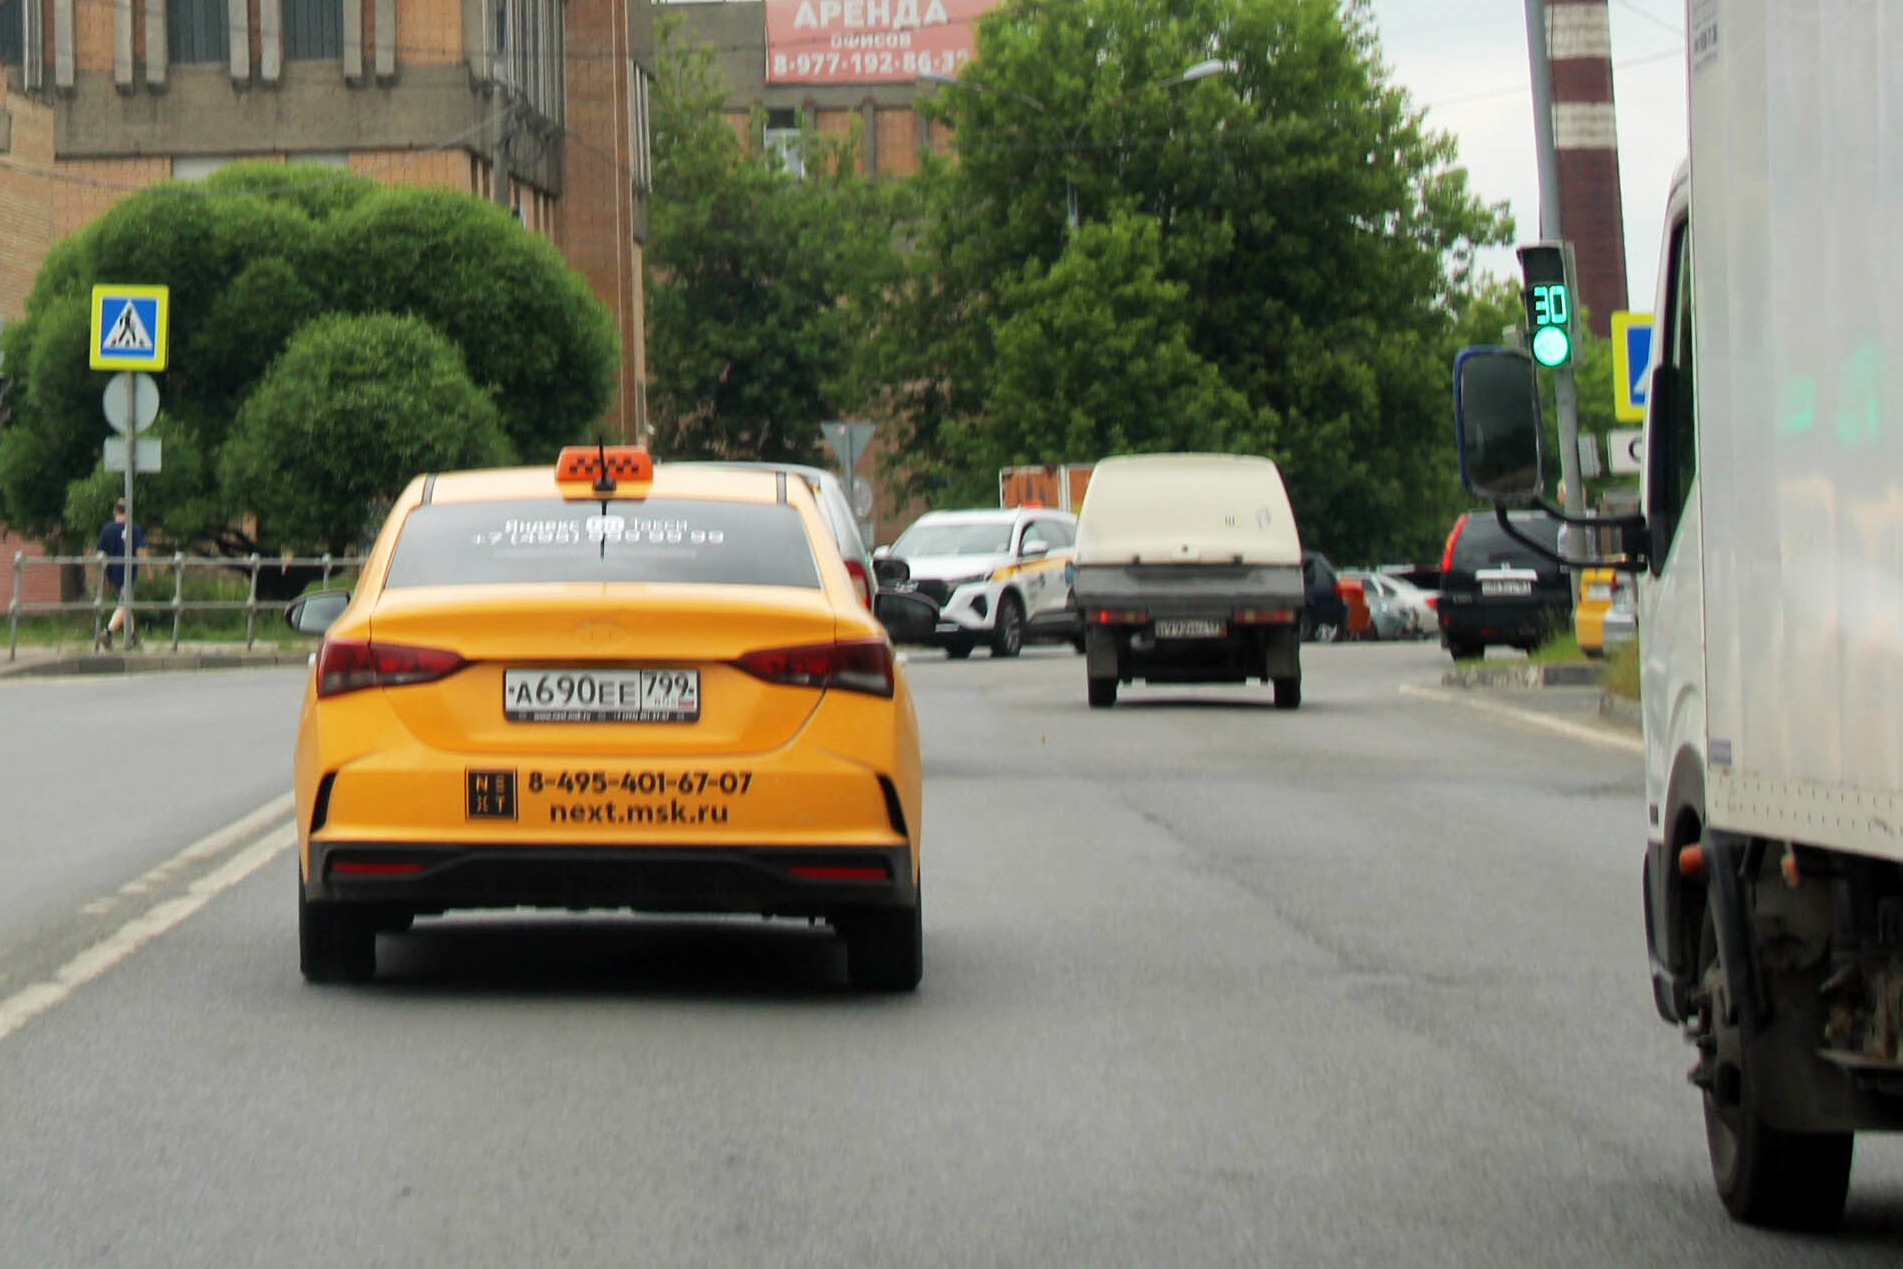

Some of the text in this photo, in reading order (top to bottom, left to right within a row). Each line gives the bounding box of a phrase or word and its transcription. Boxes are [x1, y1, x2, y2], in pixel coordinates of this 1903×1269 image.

[1534, 285, 1567, 325] 30
[644, 671, 689, 697] 799
[528, 771, 753, 795] 8-495-401-67-07
[550, 799, 729, 823] next.msk.ru
